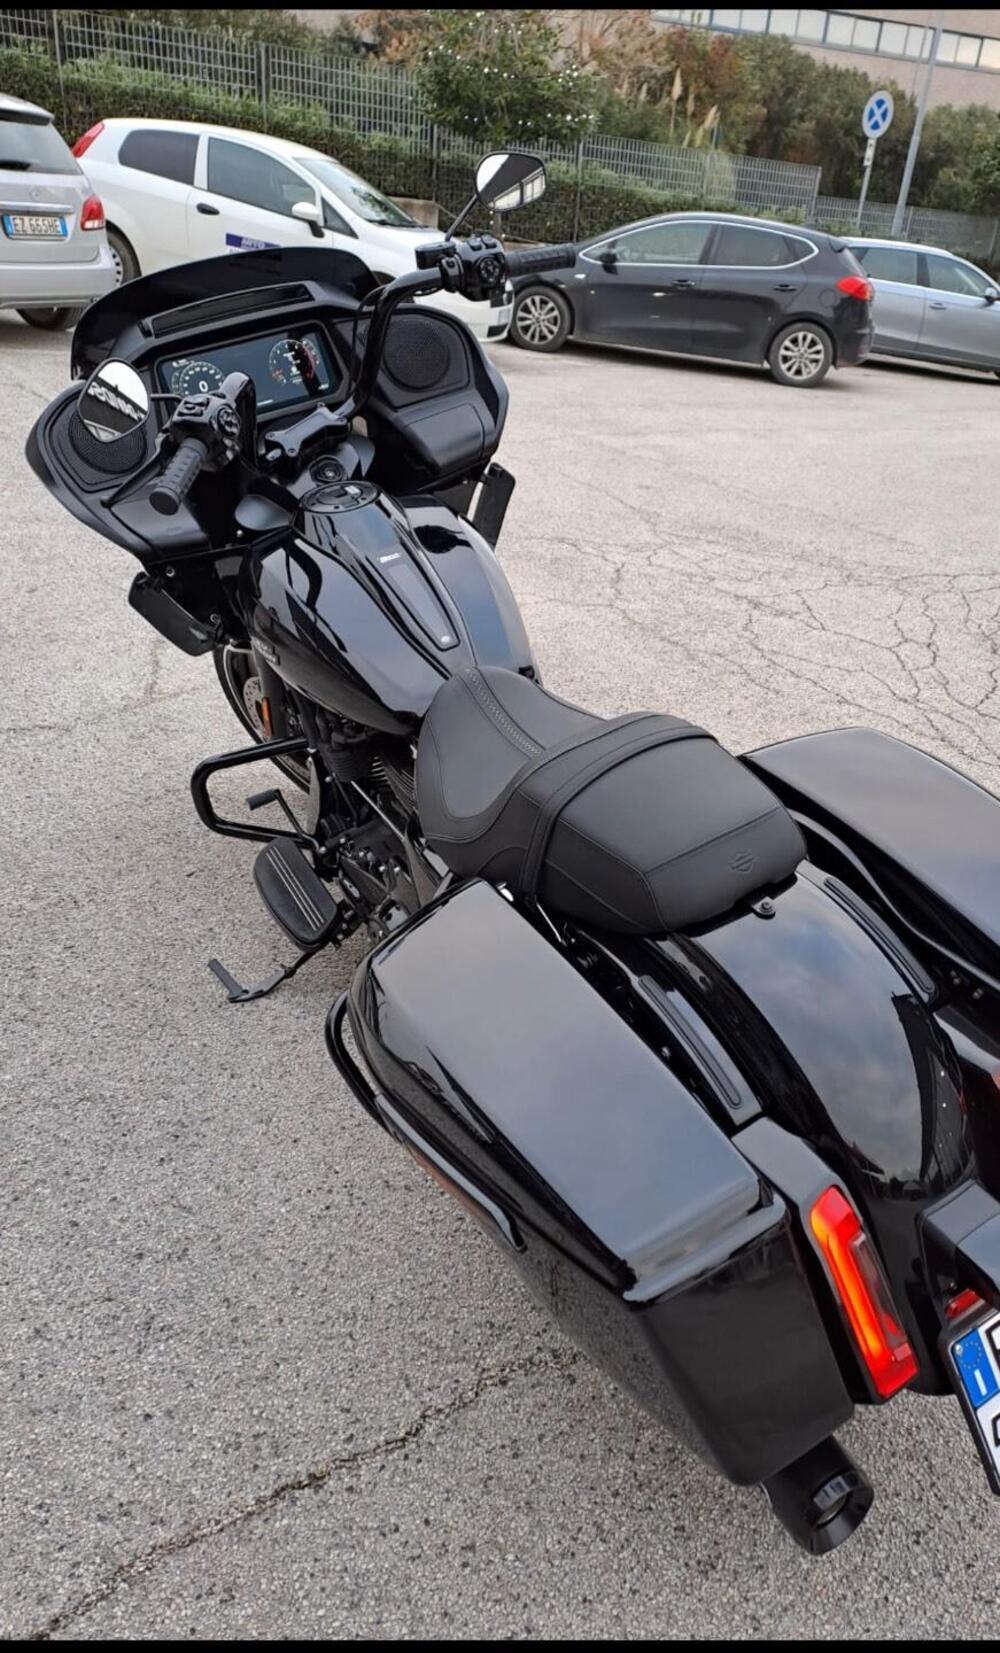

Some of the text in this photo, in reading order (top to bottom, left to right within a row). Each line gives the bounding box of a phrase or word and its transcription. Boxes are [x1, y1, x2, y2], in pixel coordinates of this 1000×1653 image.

[12, 217, 27, 233] EZ
[198, 380, 209, 393] 0
[974, 1368, 987, 1396] I
